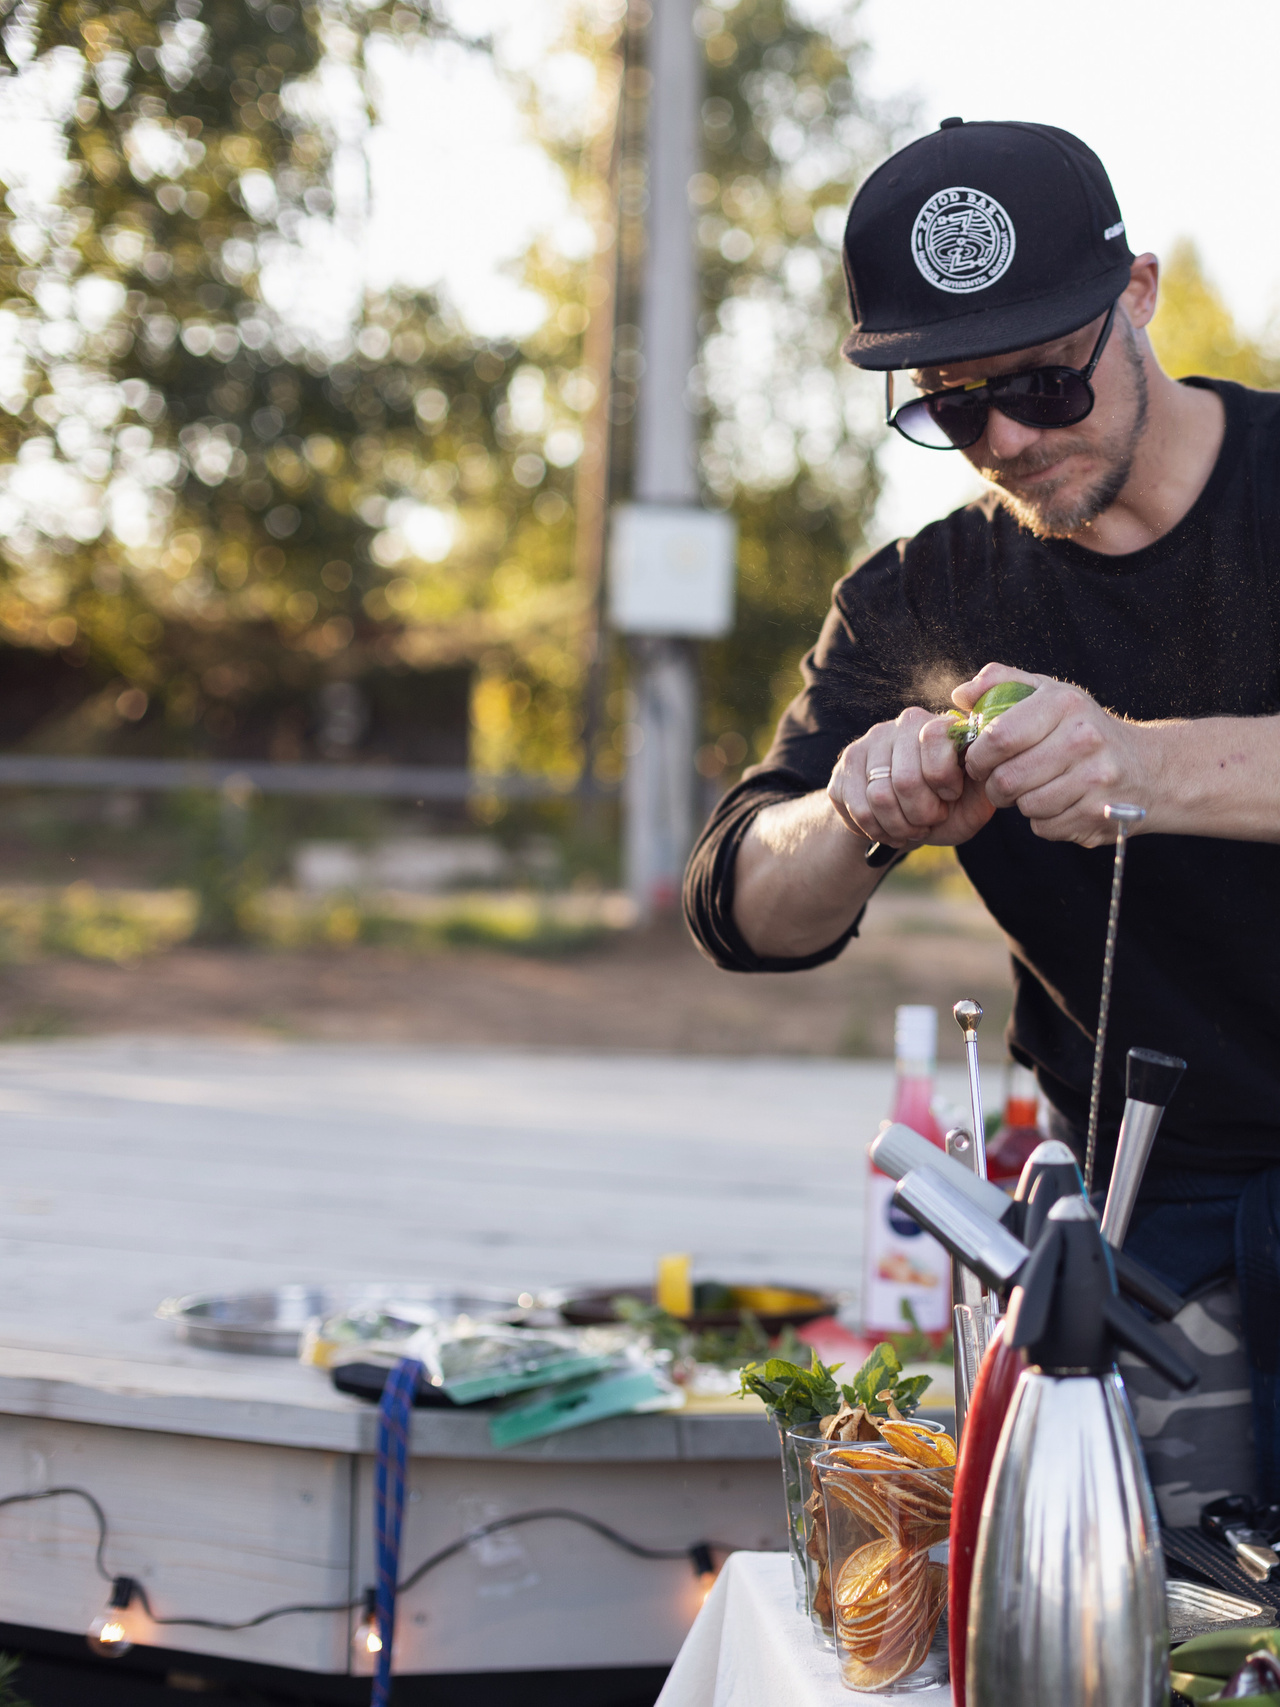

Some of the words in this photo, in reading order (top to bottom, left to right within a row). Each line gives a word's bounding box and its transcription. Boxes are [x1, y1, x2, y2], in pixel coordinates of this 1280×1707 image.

[918, 191, 960, 231] ZAVOD
[966, 192, 998, 217] BAR
[940, 275, 988, 289] AUTHENTIC
[988, 230, 1010, 277] GASTROBAR
